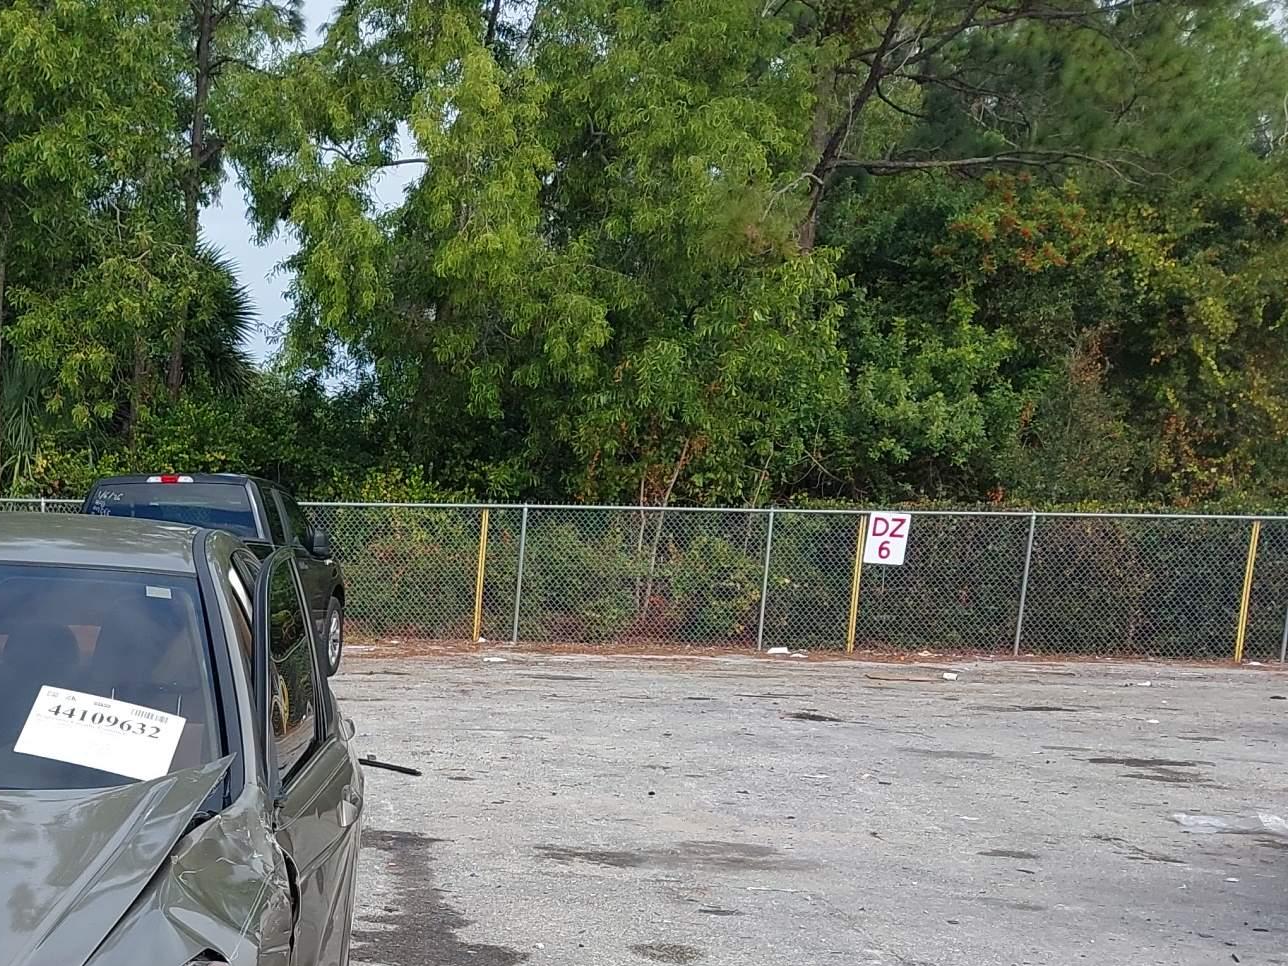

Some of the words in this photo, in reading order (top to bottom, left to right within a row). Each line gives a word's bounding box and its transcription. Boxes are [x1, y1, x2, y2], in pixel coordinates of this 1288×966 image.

[872, 516, 906, 538] DZ
[878, 540, 891, 559] 6
[47, 703, 162, 739] 44109632
